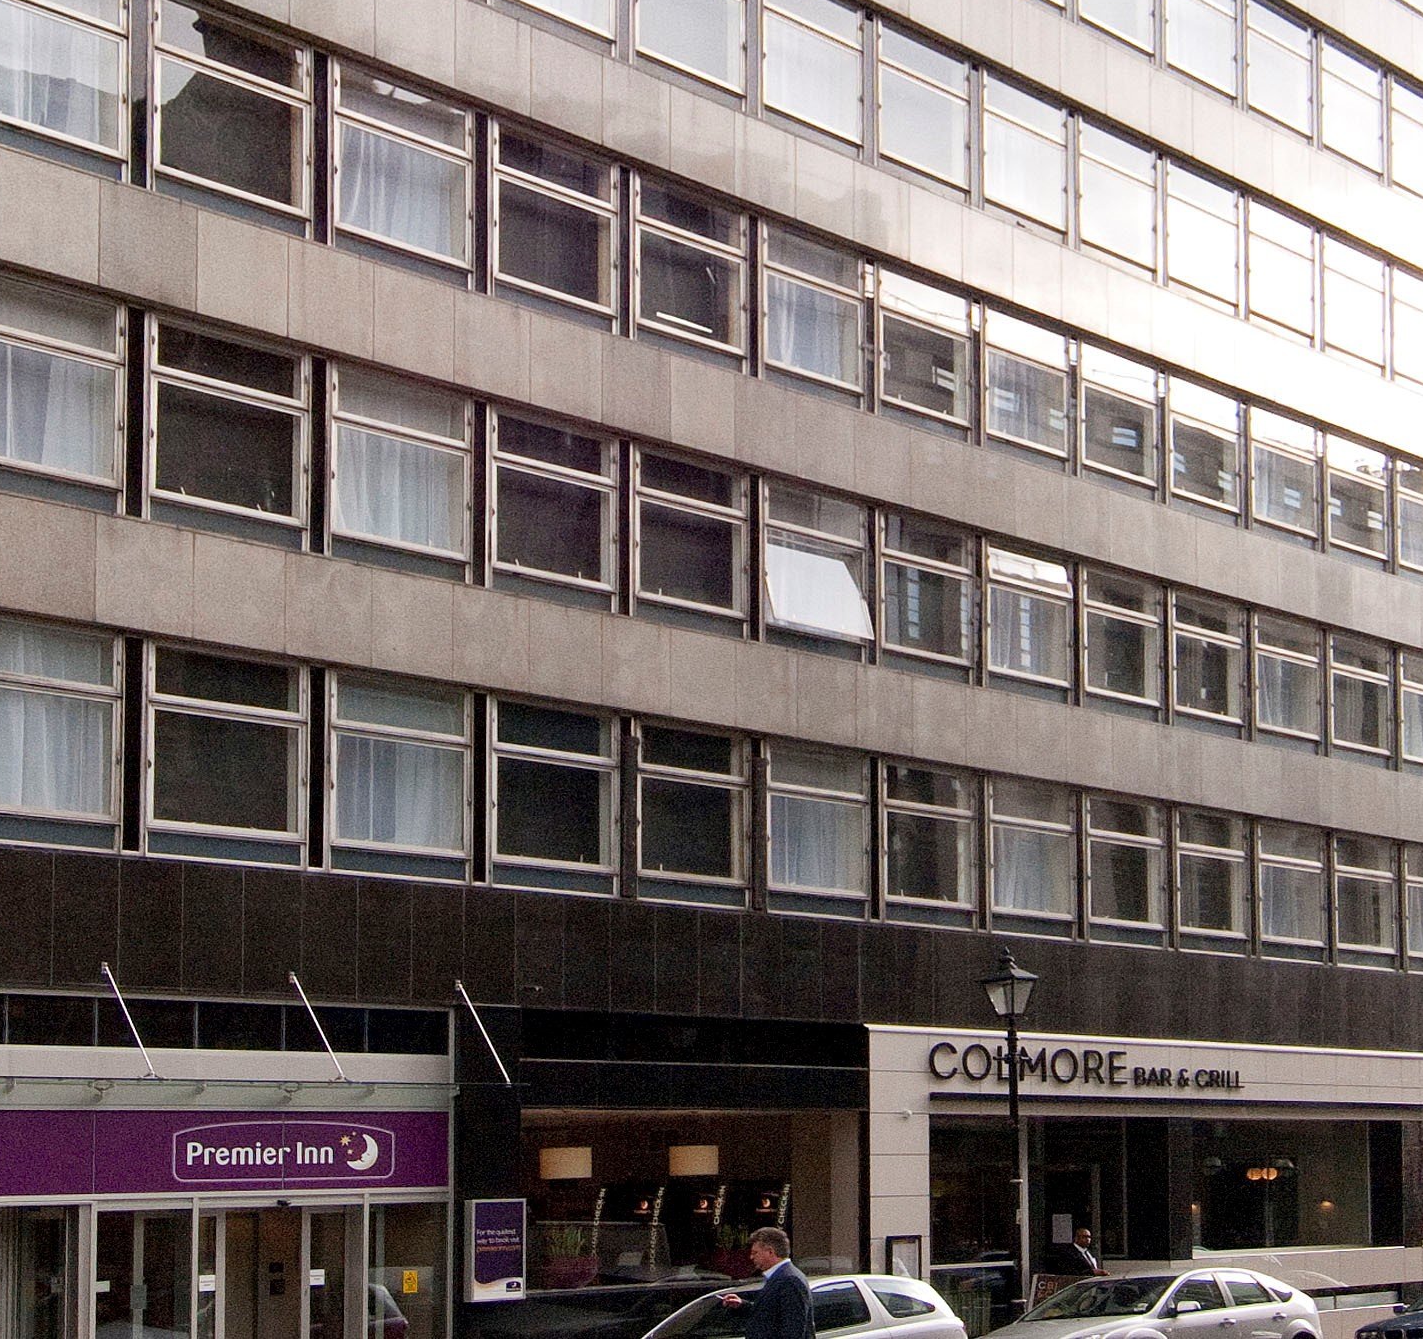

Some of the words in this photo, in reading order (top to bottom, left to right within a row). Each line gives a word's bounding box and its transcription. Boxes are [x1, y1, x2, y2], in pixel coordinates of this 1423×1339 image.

[929, 1042, 1128, 1086] COLMORE
[1133, 1066, 1172, 1088] BAR
[1178, 1068, 1190, 1089] &
[1194, 1069, 1245, 1090] GRILL
[186, 1141, 291, 1165] Premier
[296, 1141, 334, 1165] Inn
